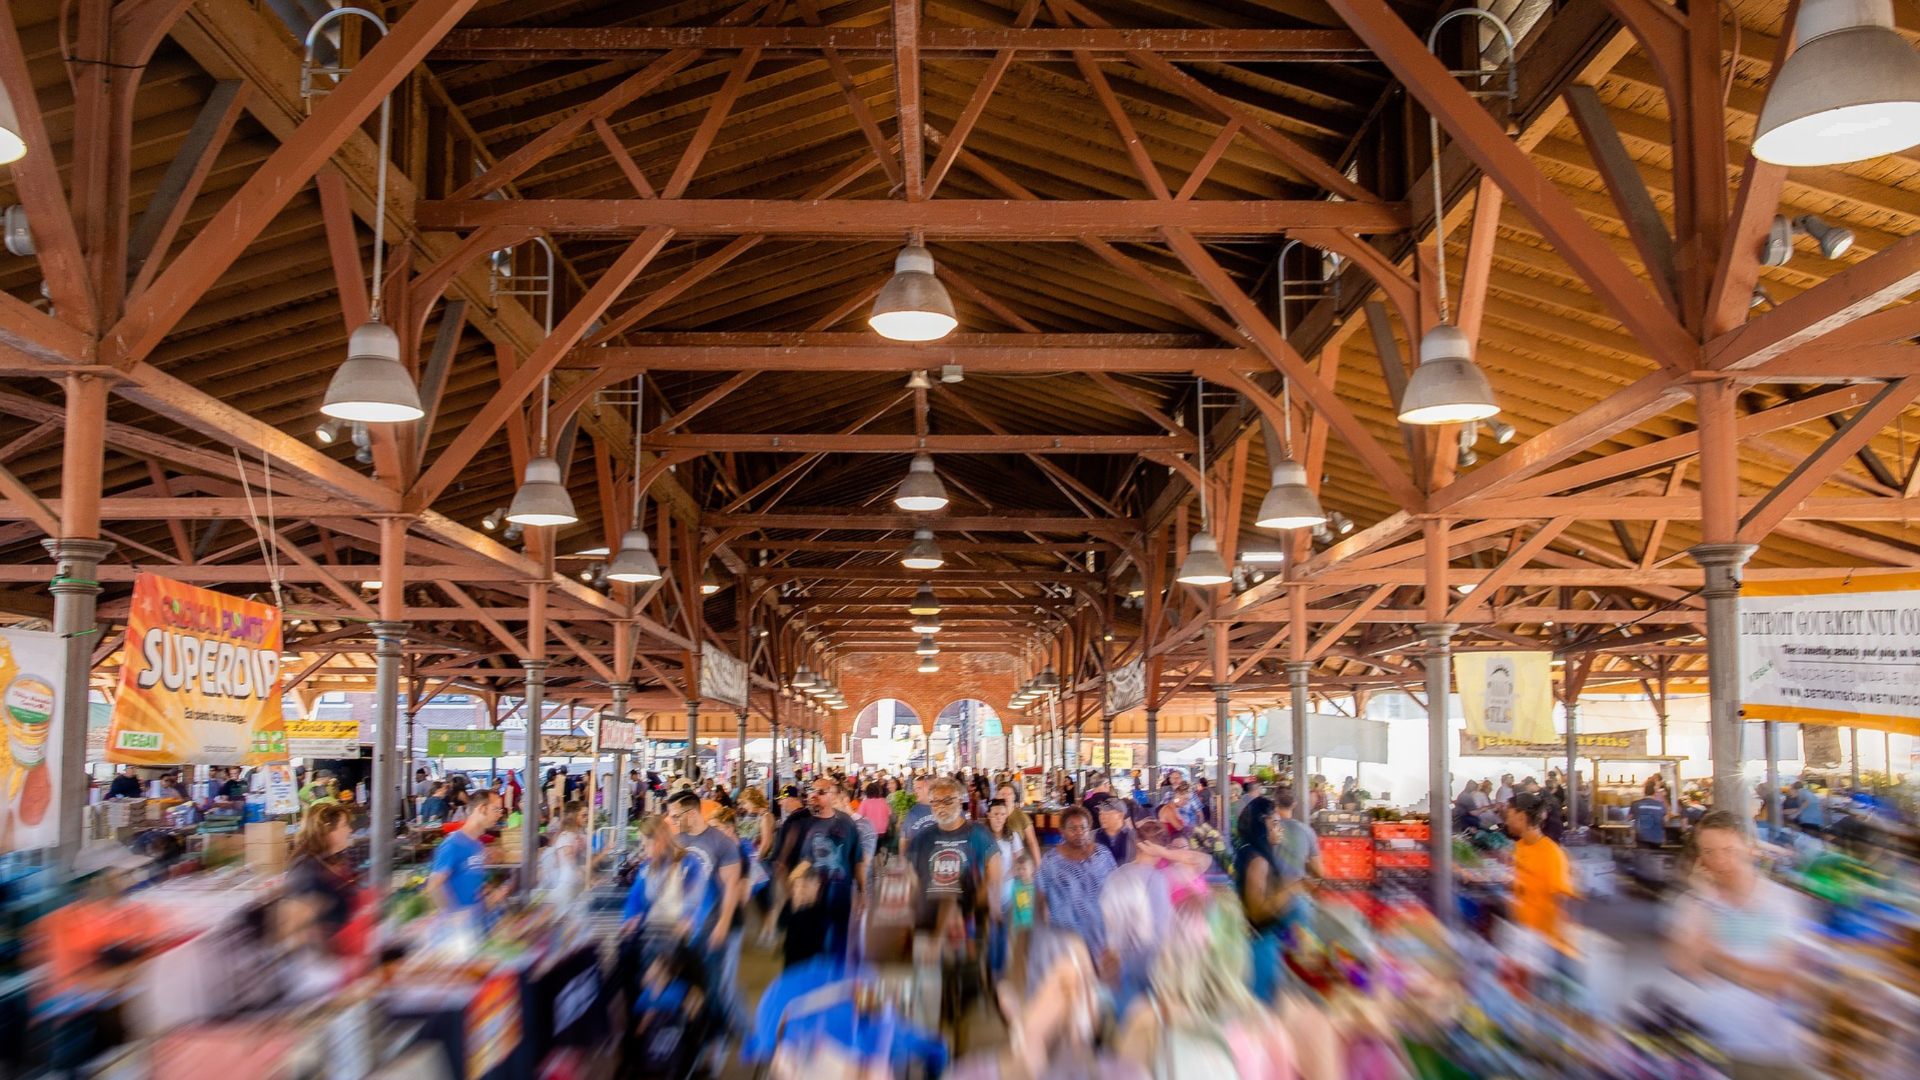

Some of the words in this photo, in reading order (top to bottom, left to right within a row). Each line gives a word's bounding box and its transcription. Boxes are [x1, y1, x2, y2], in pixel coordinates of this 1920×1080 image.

[1741, 611, 1794, 636] DETROIT
[1796, 610, 1863, 636] GOURMET
[1866, 609, 1897, 636] NUT
[138, 626, 280, 701] SUPERDIP
[123, 732, 158, 748] VEGAN
